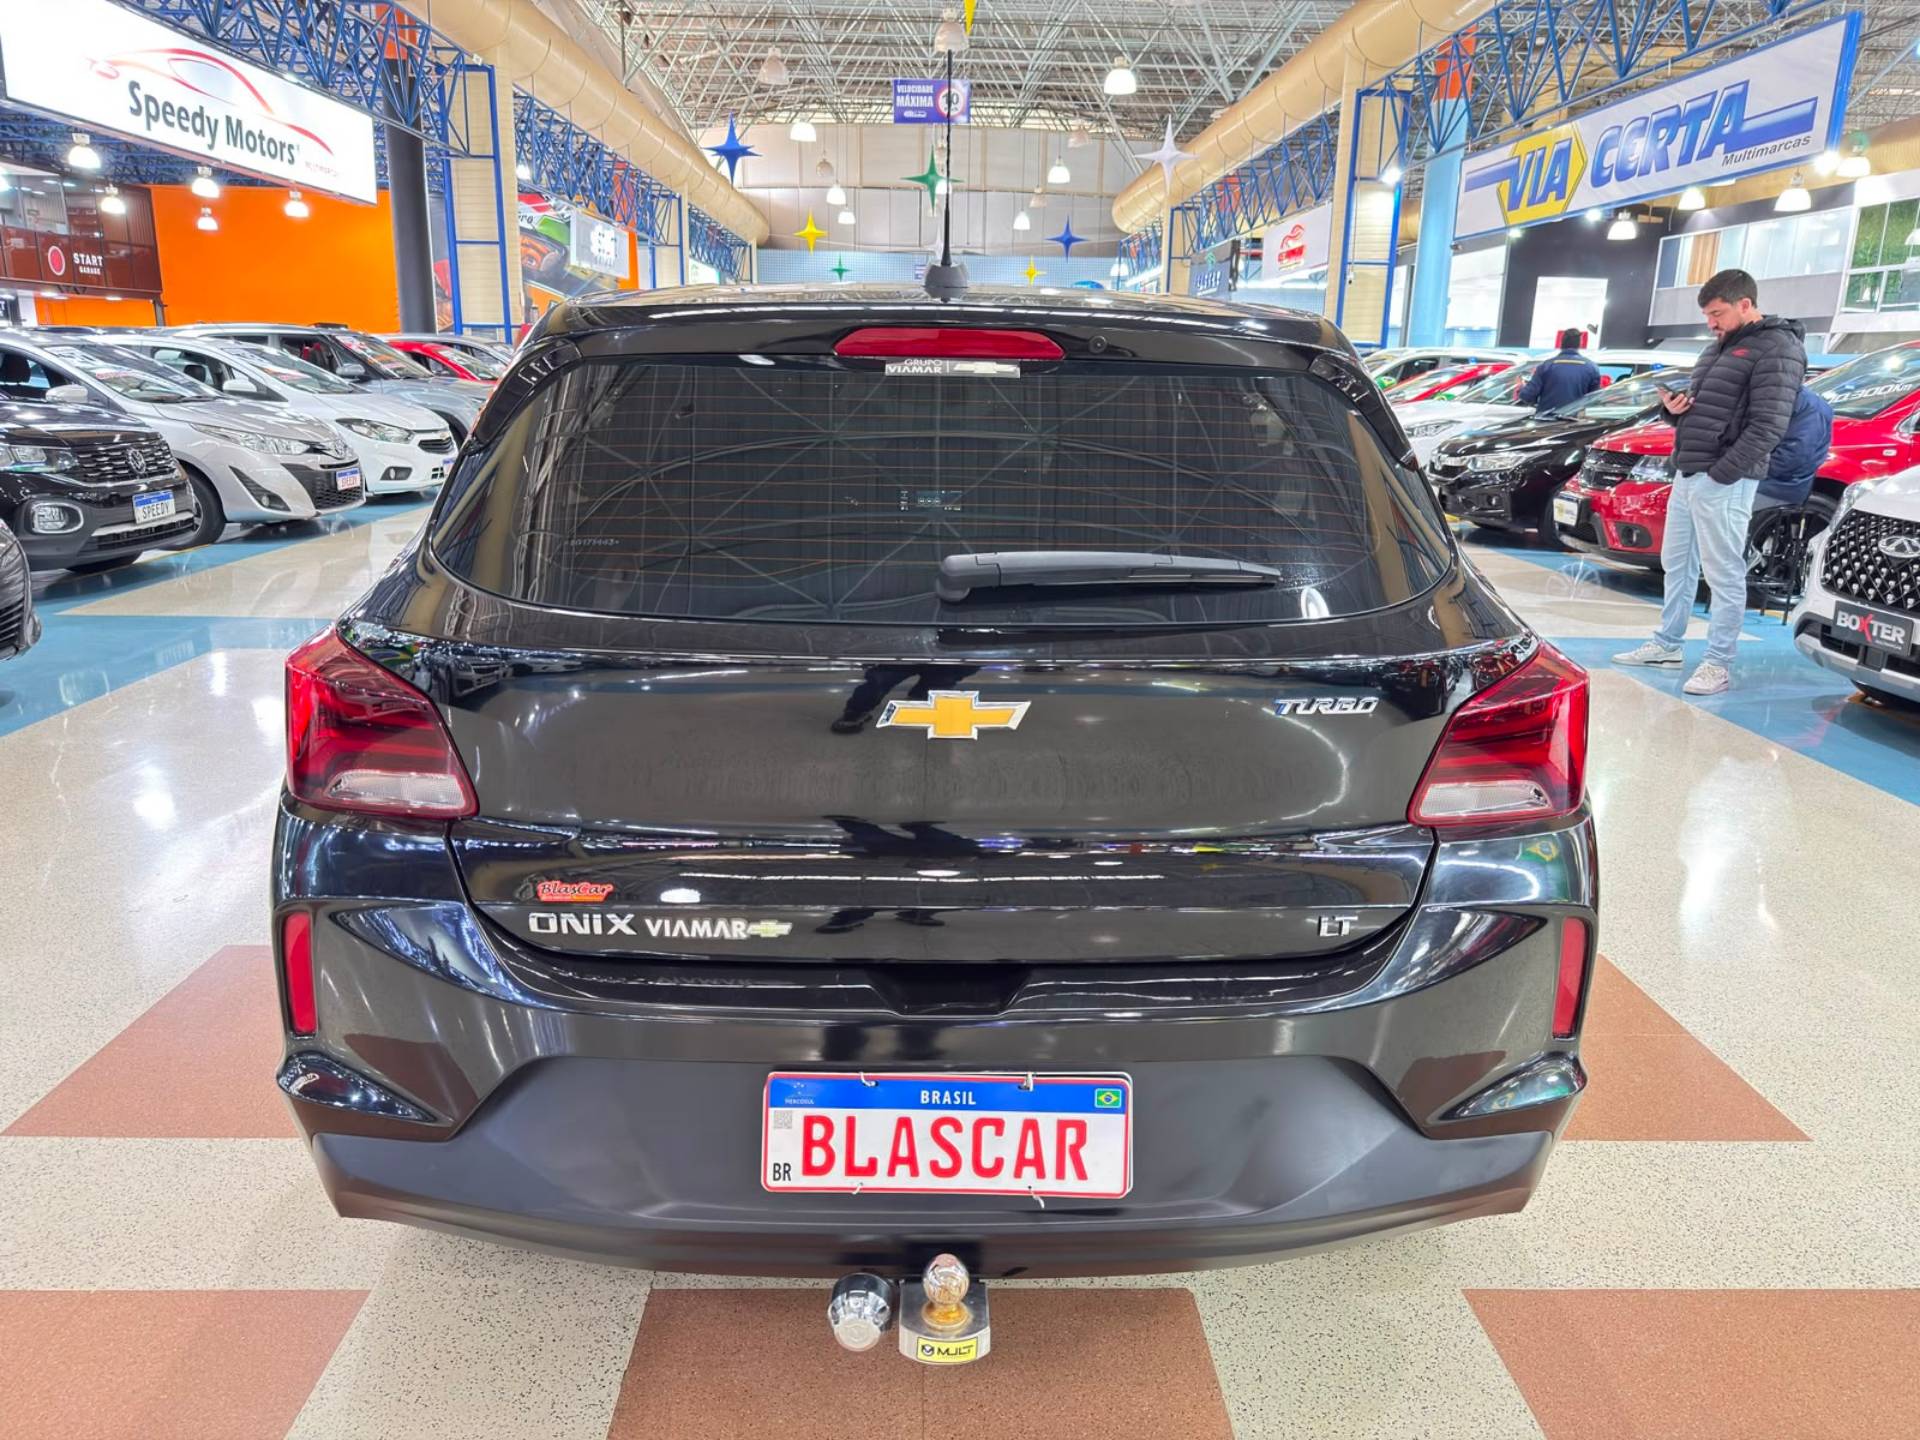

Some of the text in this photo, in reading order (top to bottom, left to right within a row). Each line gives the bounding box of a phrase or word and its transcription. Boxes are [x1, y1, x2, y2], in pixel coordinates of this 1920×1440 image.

[896, 94, 934, 108] MÁXIMA
[128, 80, 296, 165] Speedy Motors
[1507, 79, 1750, 212] VIA CERTA
[1721, 135, 1812, 168] Multimarcas
[73, 252, 103, 266] START
[887, 365, 943, 374] VIAMAR
[904, 358, 943, 366] GRUPO
[142, 502, 169, 519] SPEEDY
[1836, 610, 1906, 645] BOXTER
[1275, 696, 1379, 716] TURBO
[528, 912, 638, 936] ONIX
[644, 918, 747, 940] VIAMAR
[1318, 916, 1359, 937] LT
[920, 1089, 977, 1106] BRASIL
[801, 1114, 1089, 1181] BLASCAR
[772, 1162, 792, 1182] BR
